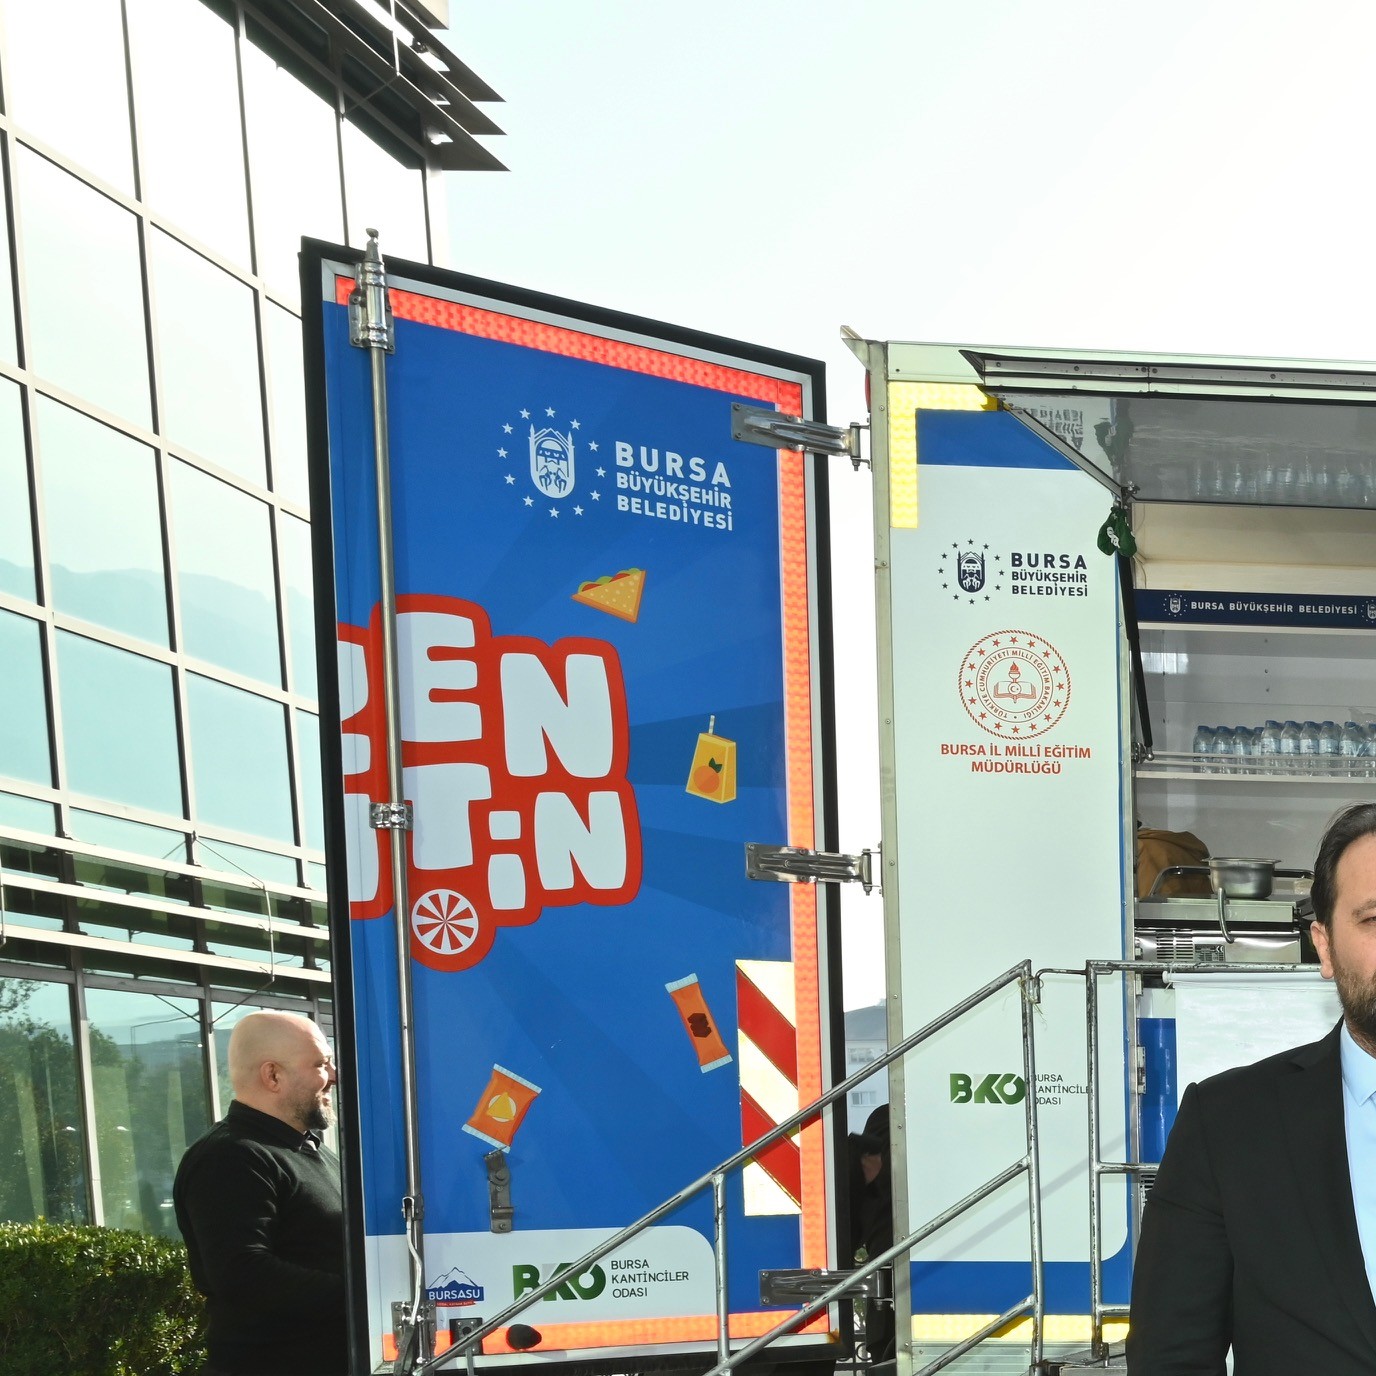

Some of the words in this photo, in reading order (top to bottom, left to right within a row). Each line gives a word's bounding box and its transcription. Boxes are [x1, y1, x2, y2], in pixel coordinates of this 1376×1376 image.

[615, 440, 731, 488] BURSA
[616, 471, 732, 508] BÜYÜKŞEHİR
[617, 495, 734, 531] BELEDİYESİ
[1010, 552, 1088, 570] BURSA
[1012, 568, 1088, 584] BÜYÜKŞEHİR
[1012, 583, 1088, 597] BELEDİYESİ
[1191, 601, 1224, 613] BURSA
[1229, 600, 1294, 616] BÜYÜKŞEHİR
[1298, 604, 1358, 616] BELEDİYESİ
[941, 744, 987, 756] BURSA
[989, 742, 1002, 756] İL
[1044, 745, 1091, 759] EĞİTİM
[971, 760, 1061, 775] MÜDÜRLÜĞÜ
[950, 1073, 1027, 1104] BKO
[428, 1290, 480, 1300] BURSASU
[611, 1259, 650, 1270] BURSA
[612, 1270, 690, 1284] KANTİNCİLER
[612, 1288, 648, 1298] ODASI
